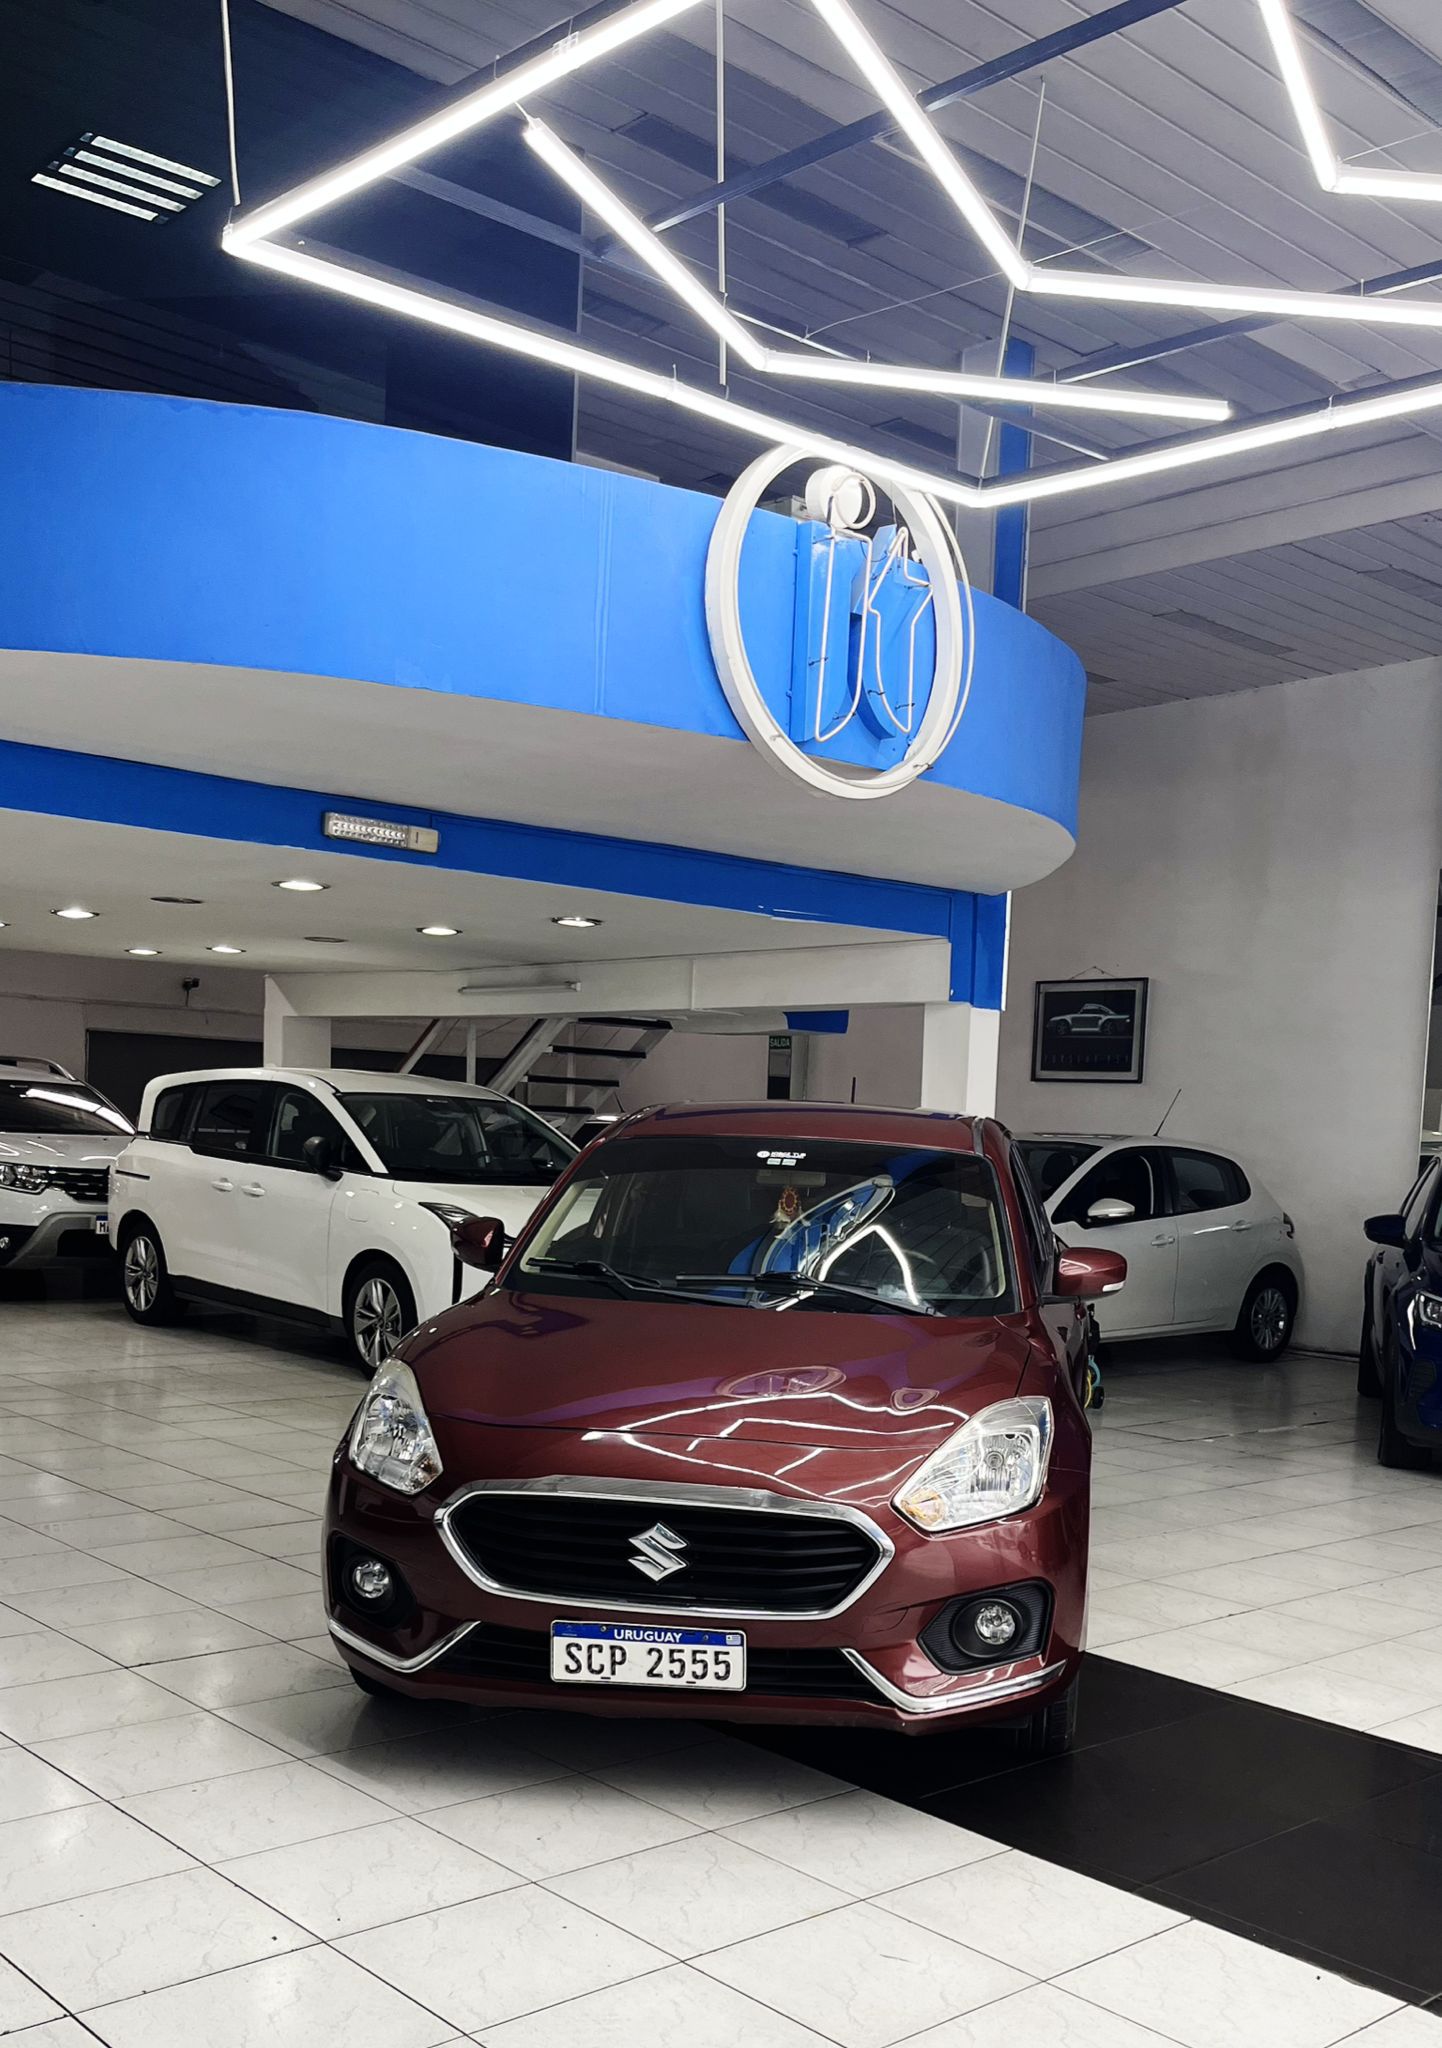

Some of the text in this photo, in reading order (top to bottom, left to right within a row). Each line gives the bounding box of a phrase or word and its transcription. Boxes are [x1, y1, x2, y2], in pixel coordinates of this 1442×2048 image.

[614, 1628, 683, 1644] URUGUAY
[564, 1642, 731, 1681] SCP 2555
